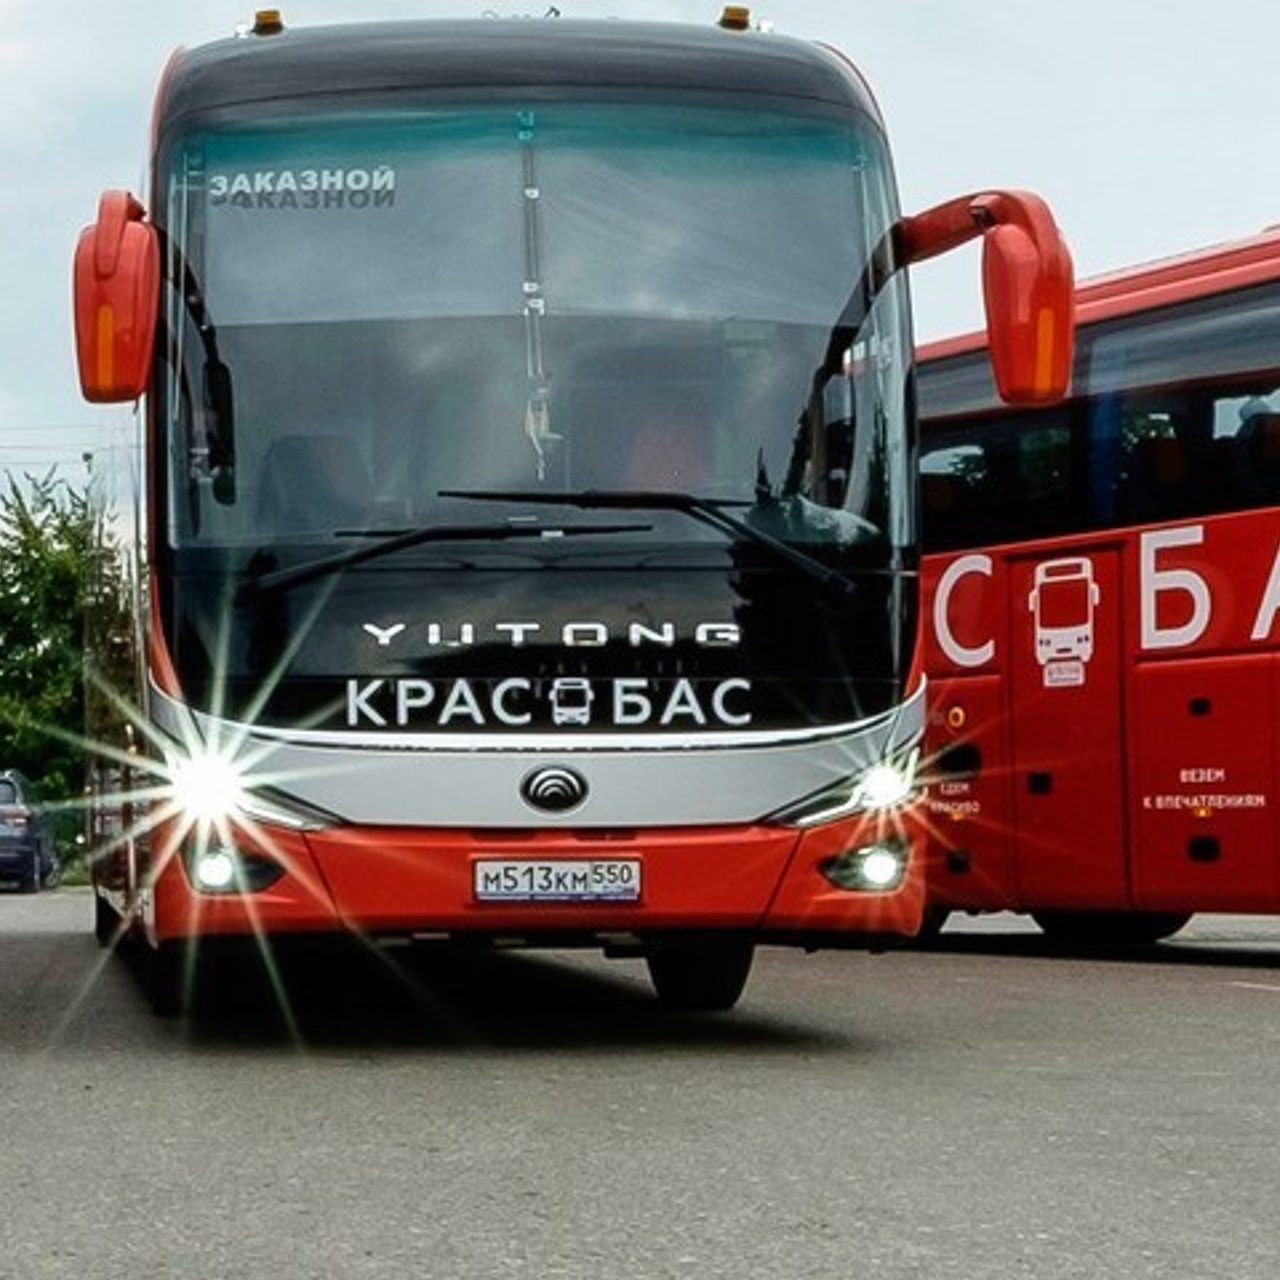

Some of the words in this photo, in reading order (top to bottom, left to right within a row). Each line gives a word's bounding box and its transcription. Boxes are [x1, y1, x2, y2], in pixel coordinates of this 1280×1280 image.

[210, 165, 396, 196] ЗАКАЗНОЙ
[362, 623, 742, 647] YUTONG
[347, 678, 532, 726] КРАС
[613, 678, 753, 726] БАС
[484, 867, 588, 891] М513КМ
[592, 864, 633, 884] 550
